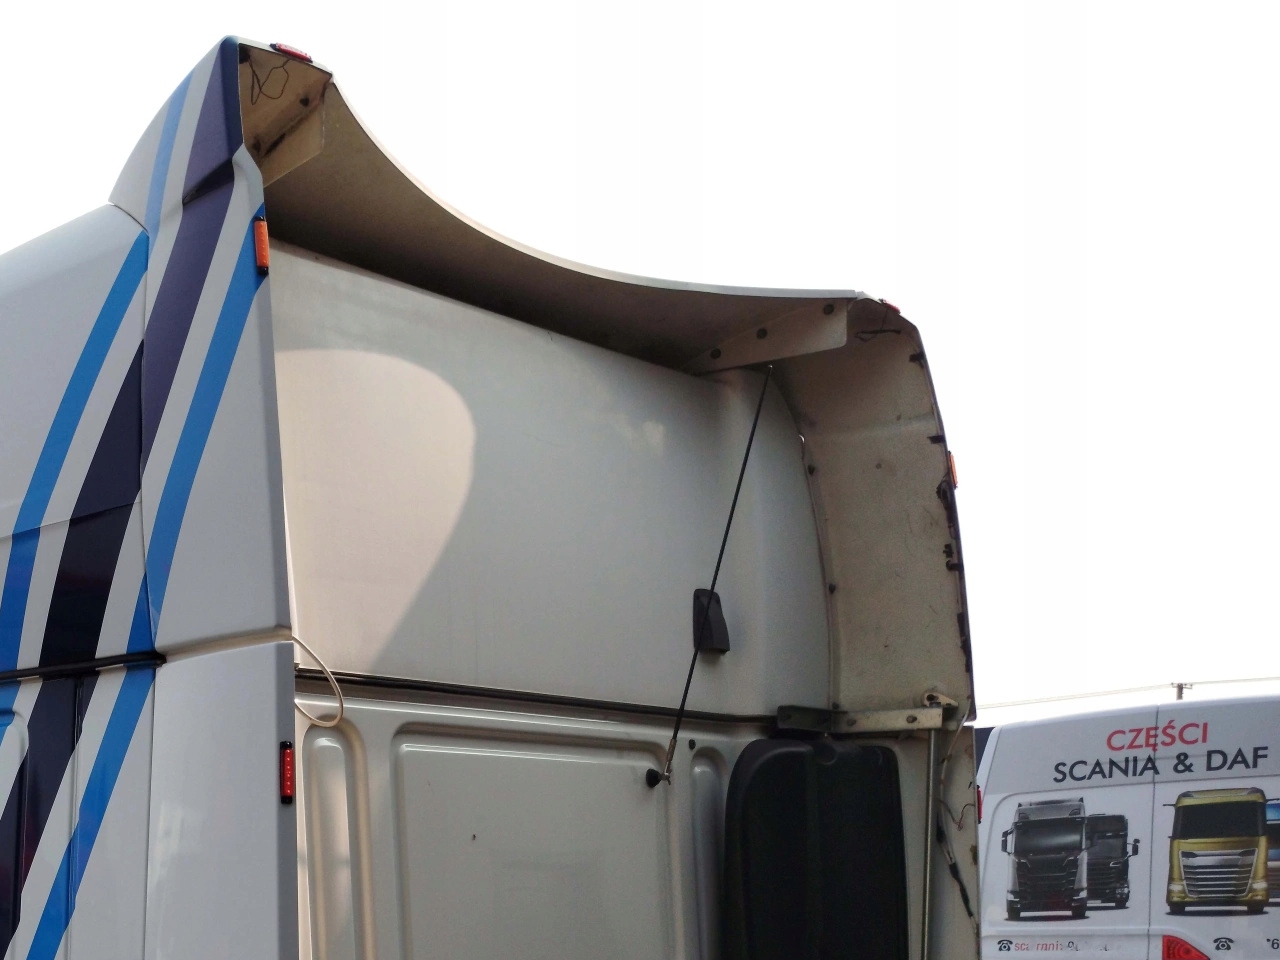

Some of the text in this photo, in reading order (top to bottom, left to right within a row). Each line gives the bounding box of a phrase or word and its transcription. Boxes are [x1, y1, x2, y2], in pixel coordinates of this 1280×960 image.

[1106, 720, 1209, 752] CZĘŚCI
[1053, 746, 1269, 783] SCANIA & DAF
